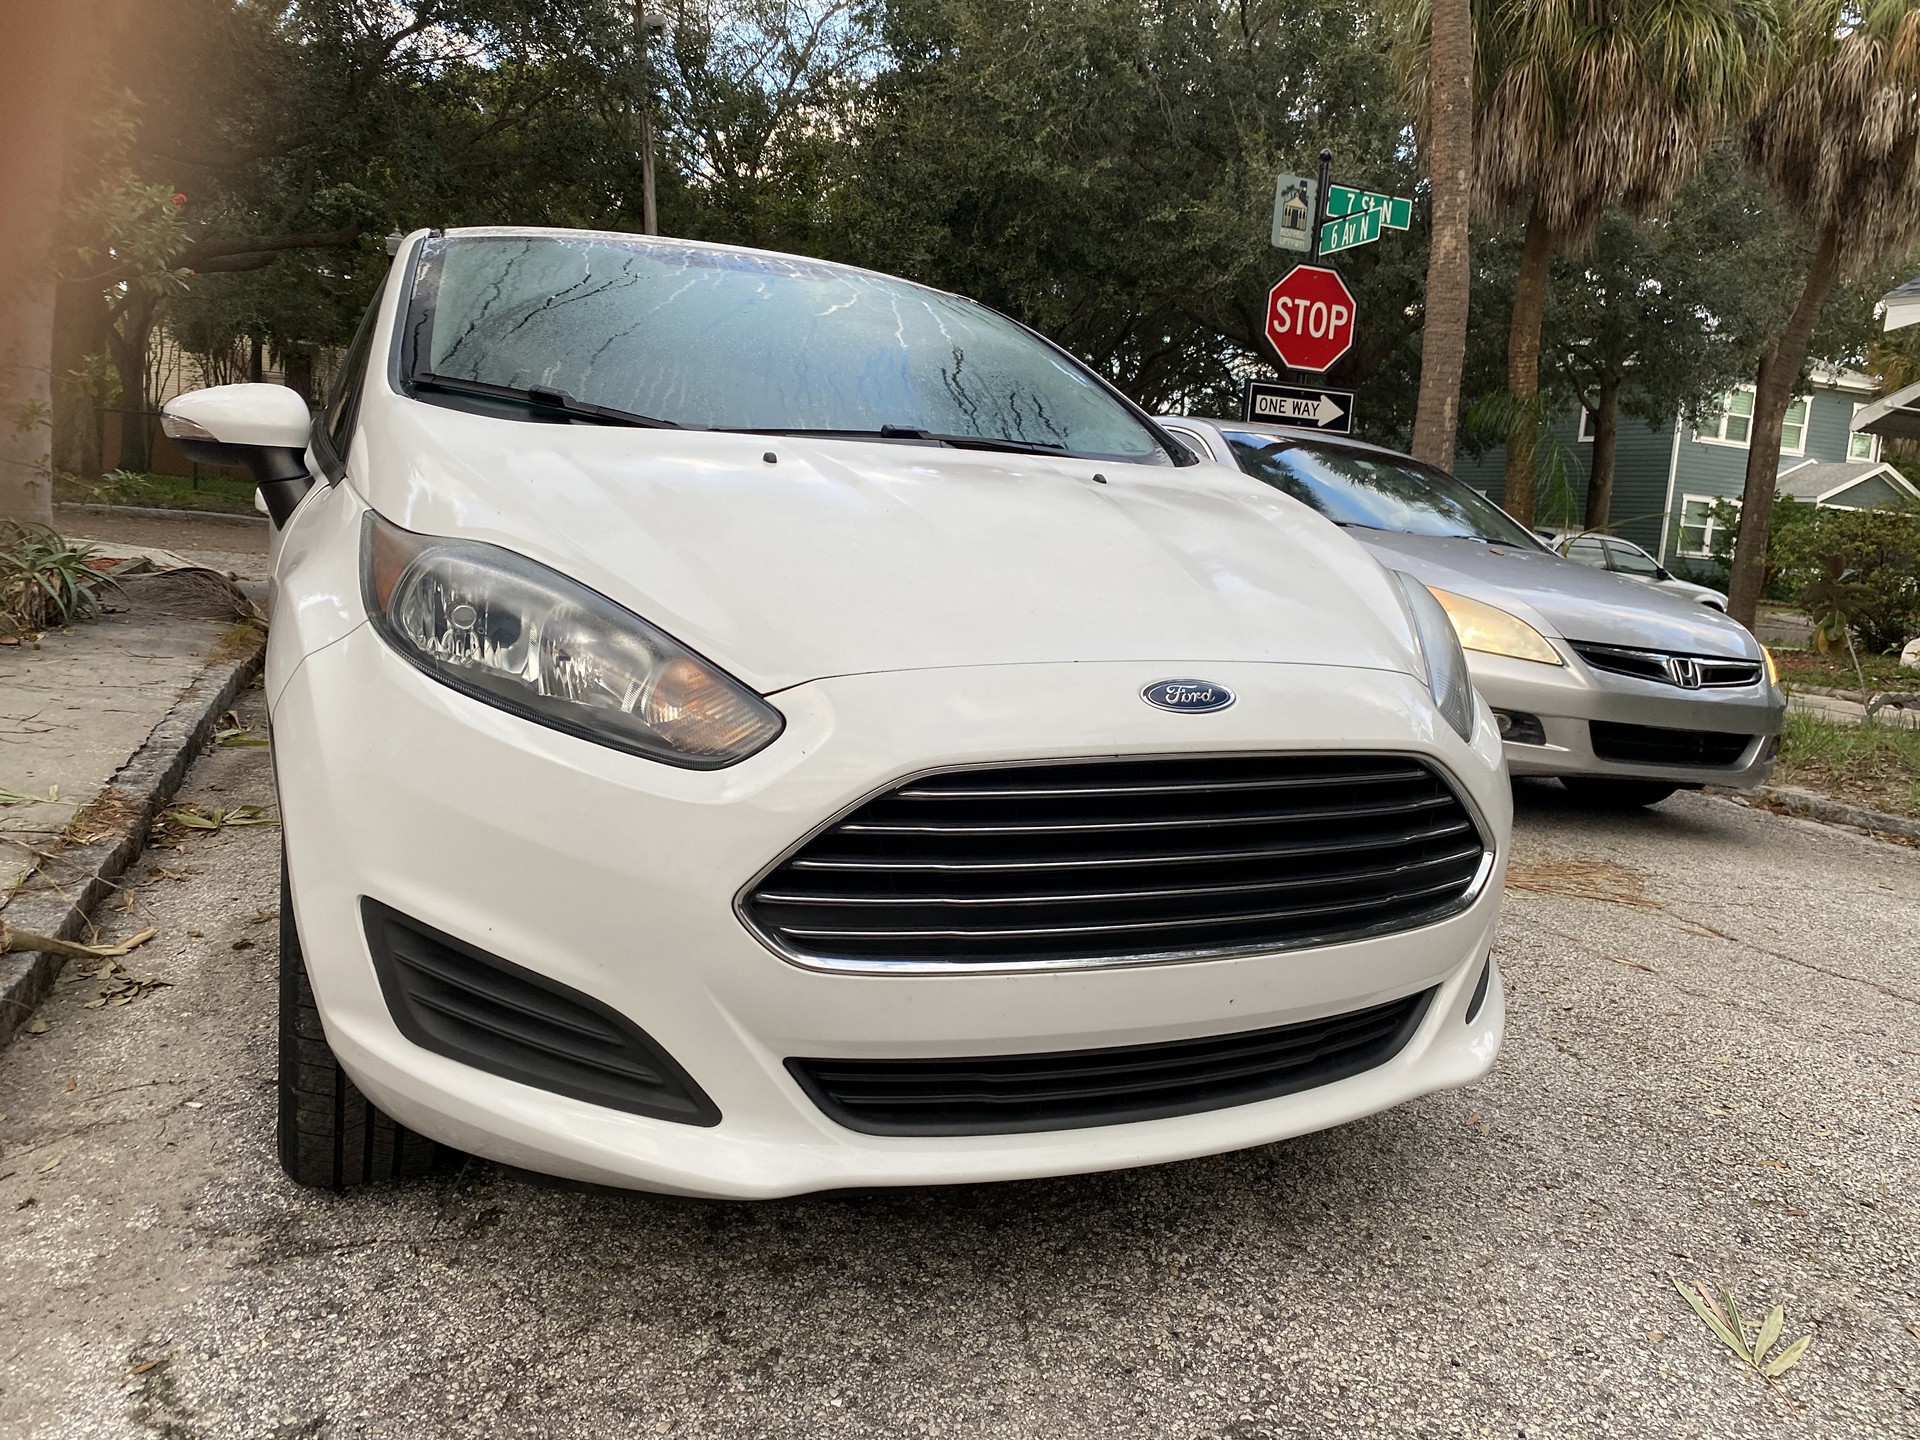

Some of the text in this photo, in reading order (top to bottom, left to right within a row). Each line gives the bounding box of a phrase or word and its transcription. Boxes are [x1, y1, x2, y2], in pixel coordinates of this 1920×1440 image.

[1347, 193, 1393, 224] 7 St N
[1331, 224, 1339, 249] 6
[1341, 221, 1357, 246] Av
[1360, 215, 1370, 241] N
[1273, 296, 1349, 340] STOP
[1259, 397, 1321, 417] ONE WAY
[1165, 684, 1216, 705] Ford
